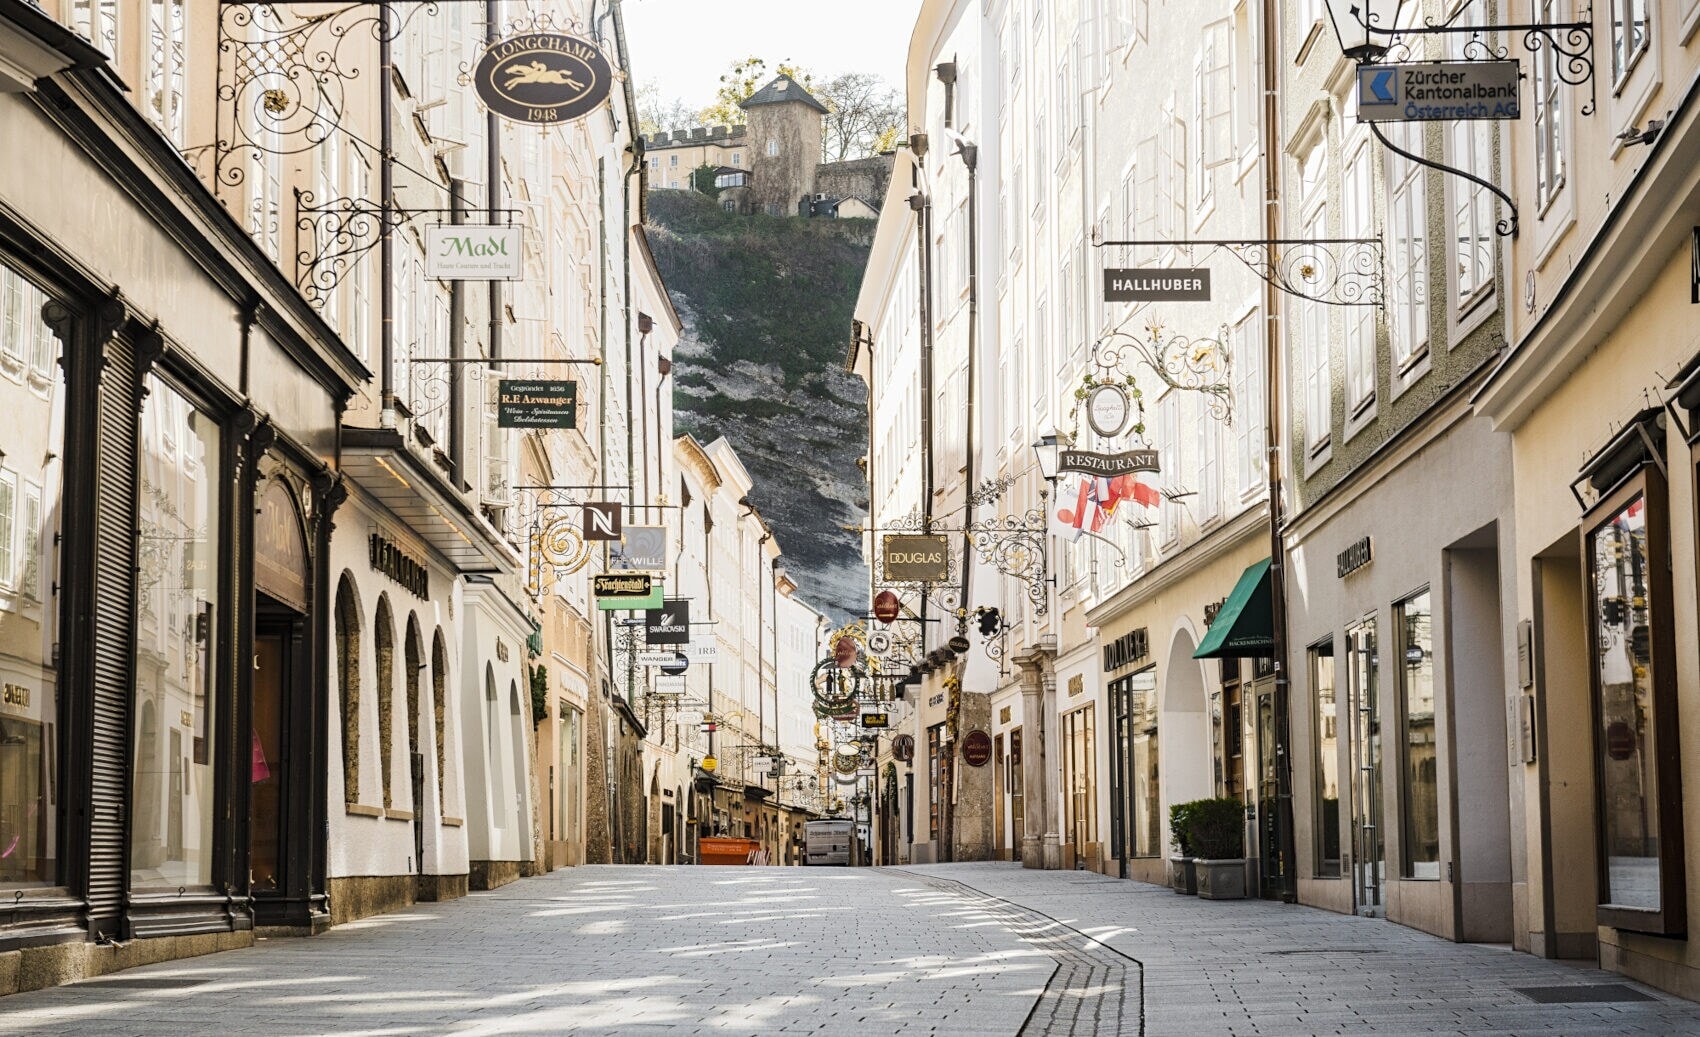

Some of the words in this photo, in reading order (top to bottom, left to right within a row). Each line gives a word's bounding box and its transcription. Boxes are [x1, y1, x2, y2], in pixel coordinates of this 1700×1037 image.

[492, 36, 596, 61] LONGCHAMP
[1405, 70, 1466, 85] Zürcher
[1405, 84, 1517, 101] Kantonalbank
[527, 108, 558, 121] 1948
[1405, 102, 1488, 118] Österreich
[1493, 103, 1518, 117] AG
[440, 236, 508, 257] Madl
[1113, 279, 1202, 291] HALLHUBER
[522, 394, 572, 406] Azwanger
[1066, 454, 1154, 471] RESTAURANT
[586, 506, 619, 537] N
[889, 552, 942, 564] DOUGLAS
[649, 625, 686, 634] SWAROVSKI
